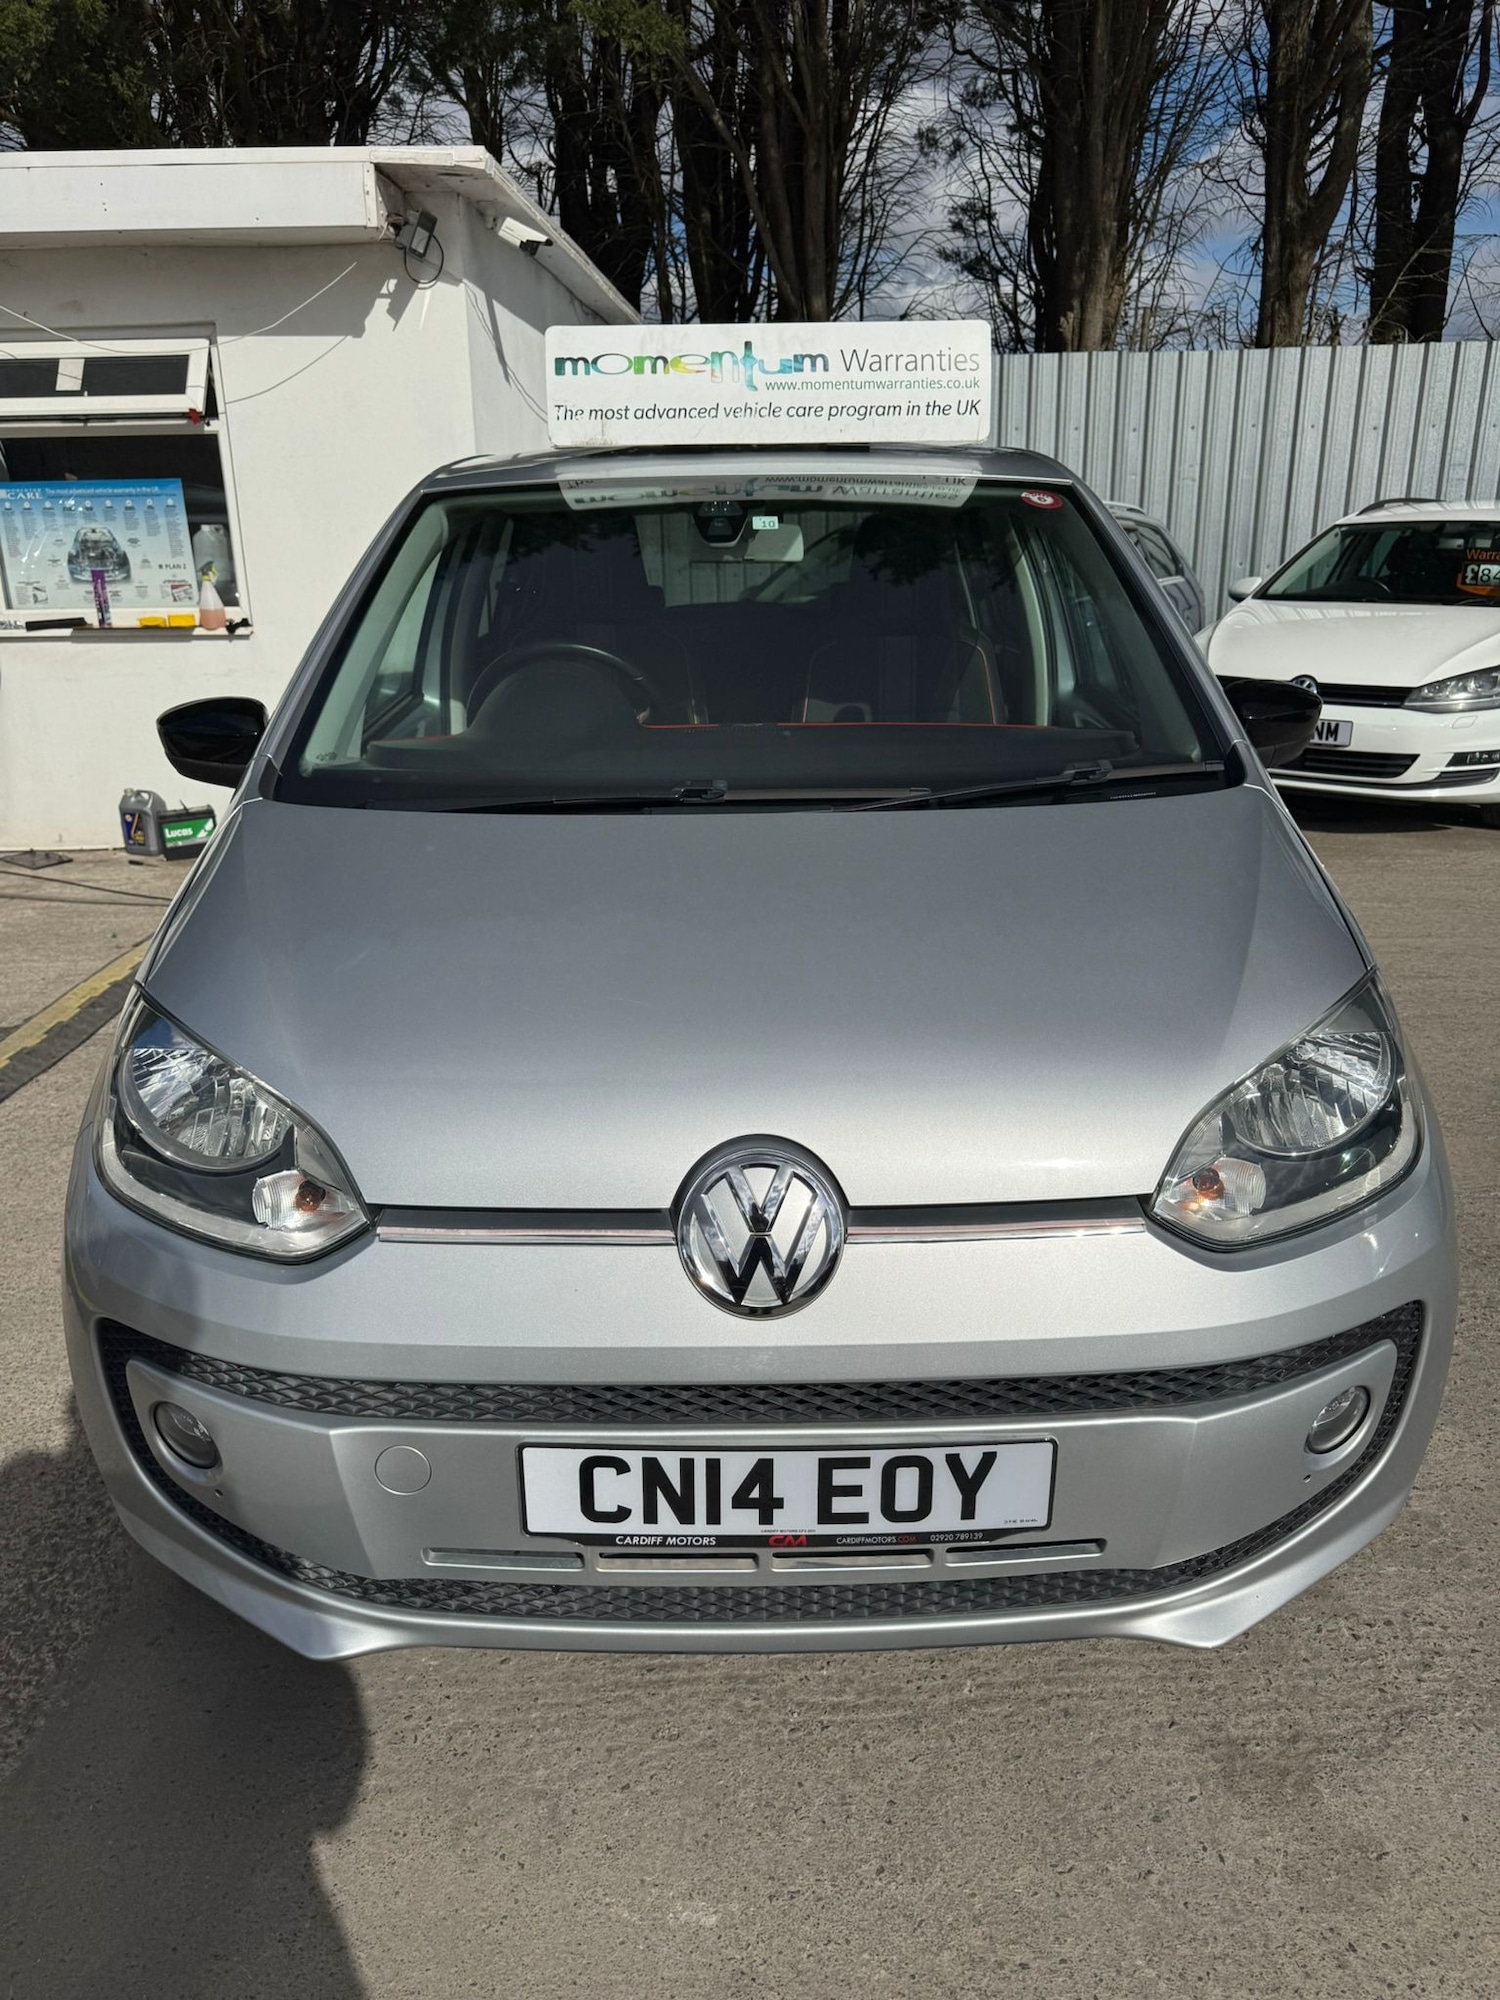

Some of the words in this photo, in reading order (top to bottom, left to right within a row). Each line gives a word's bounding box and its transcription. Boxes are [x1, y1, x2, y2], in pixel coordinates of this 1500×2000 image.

[554, 341, 829, 391] momentum
[840, 347, 980, 372] Warranties
[765, 377, 980, 390] www.momentumwarranties.co.uk
[554, 405, 584, 421] The
[588, 404, 629, 420] most
[634, 403, 719, 420] advanced
[723, 402, 782, 419] vehicle
[786, 406, 824, 418] care
[827, 404, 901, 421] program
[906, 400, 921, 416] in
[925, 400, 952, 416] the
[956, 399, 981, 416] UK
[7, 491, 42, 500] CARE
[164, 827, 194, 838] Lucas
[579, 1455, 785, 1525] CN14
[817, 1451, 998, 1524] EOY
[615, 1536, 663, 1545] CARDIFF
[666, 1536, 717, 1546] MOTORS
[767, 1535, 808, 1547] CM
[930, 1534, 954, 1542] 02920
[955, 1532, 984, 1541] 789139
